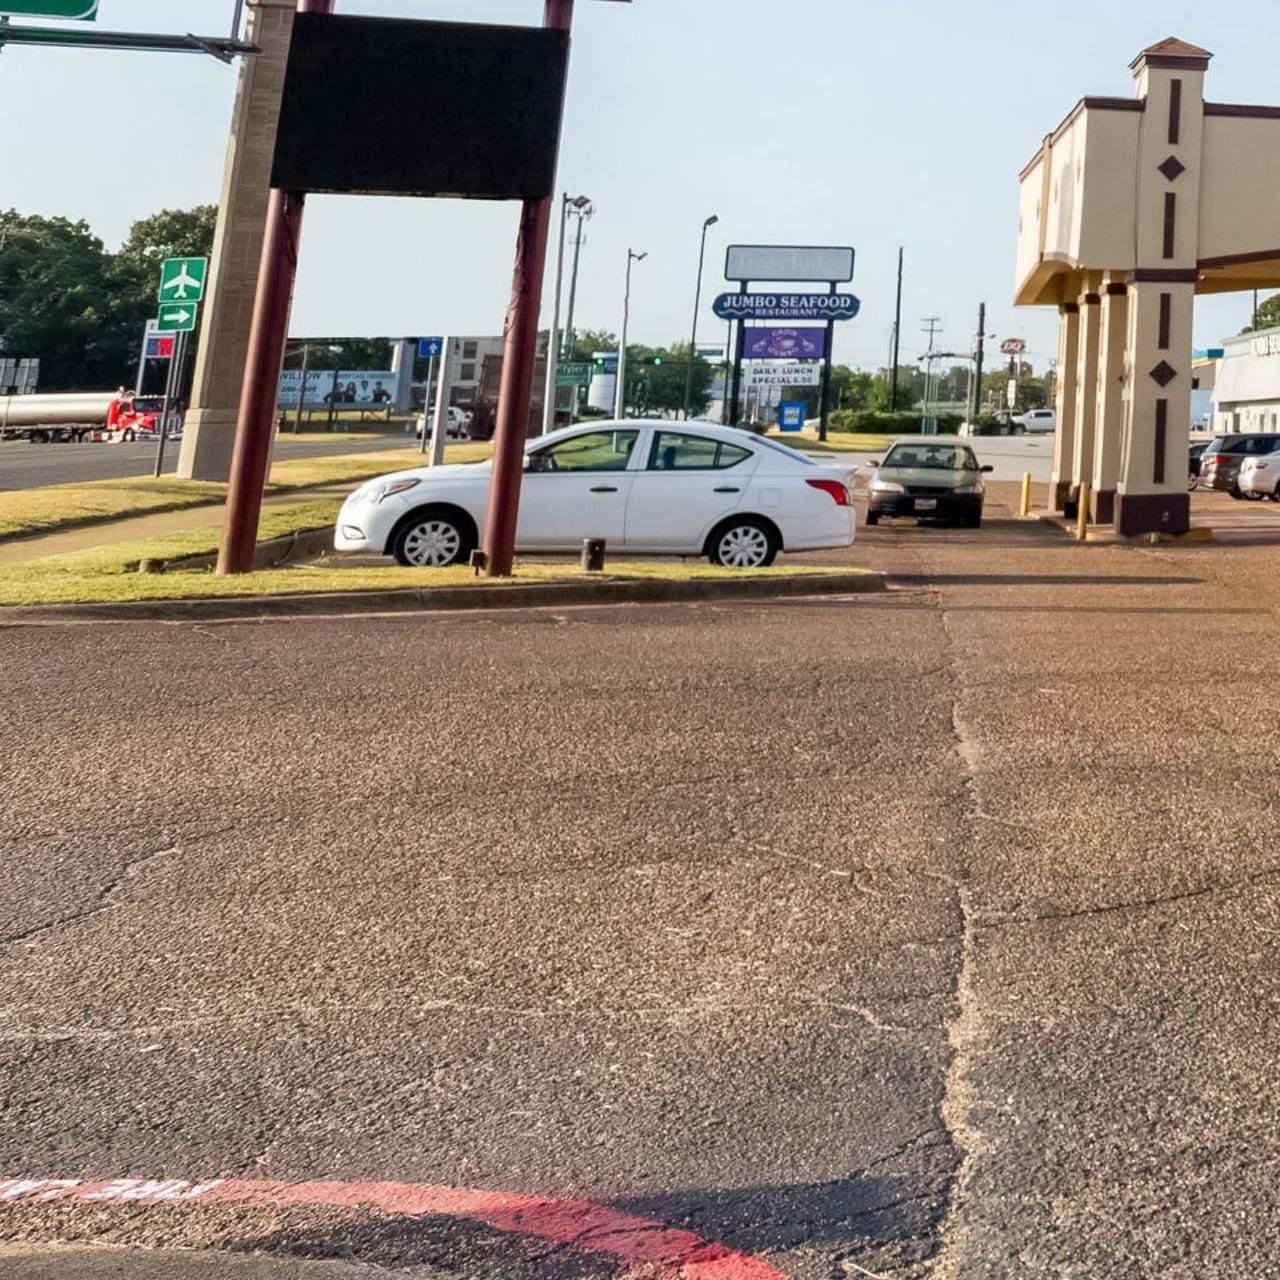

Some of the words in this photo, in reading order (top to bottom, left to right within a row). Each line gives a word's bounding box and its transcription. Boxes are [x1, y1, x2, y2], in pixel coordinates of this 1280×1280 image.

[723, 295, 776, 308] JUMBO
[780, 295, 850, 308] SEAFOOD
[754, 307, 819, 317] RESTAURANT
[753, 367, 777, 375] DAILY
[783, 367, 813, 375] LUNCH
